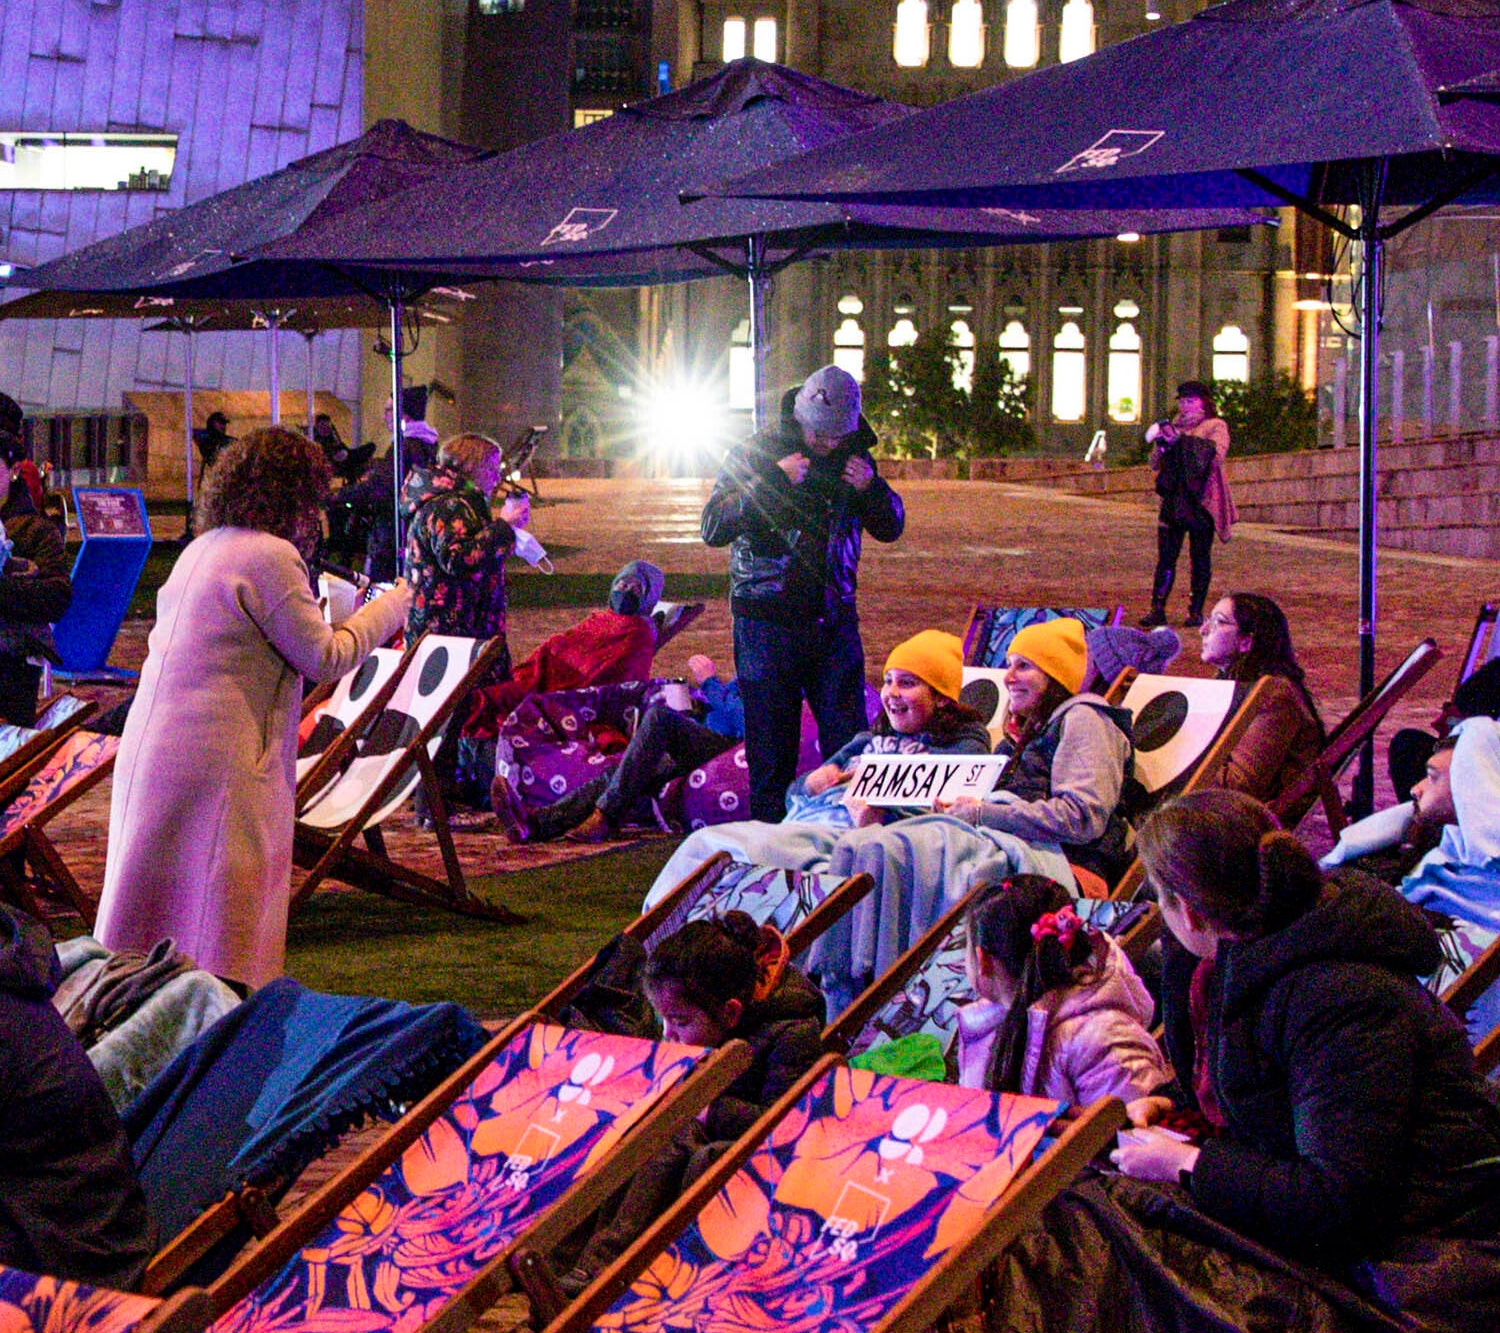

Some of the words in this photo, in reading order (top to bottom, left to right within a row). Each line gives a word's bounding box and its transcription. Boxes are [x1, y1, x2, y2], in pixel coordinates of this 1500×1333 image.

[852, 763, 961, 798] RAMSAY
[965, 764, 987, 783] ST
[820, 1215, 859, 1238] FED
